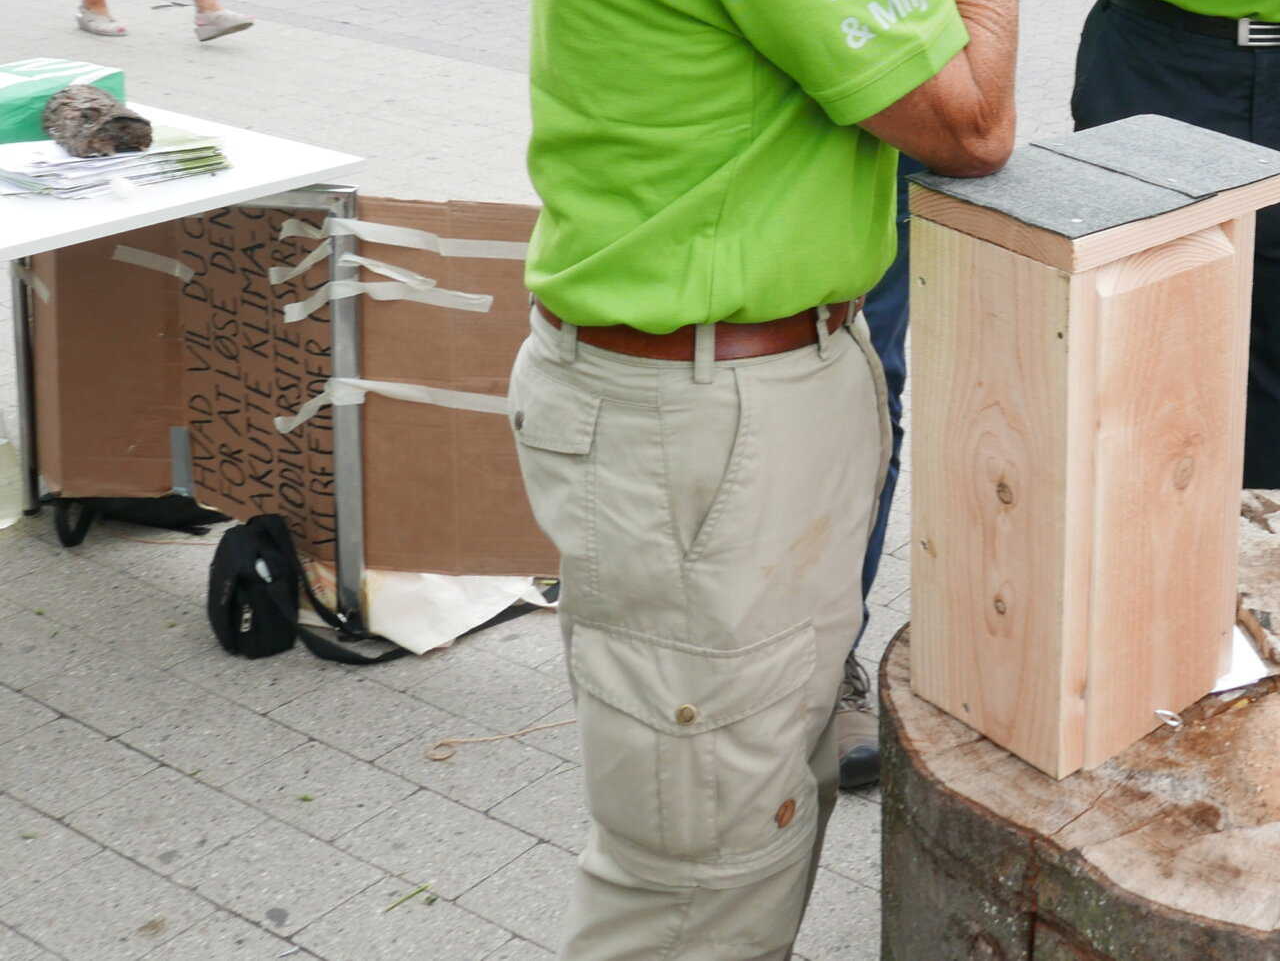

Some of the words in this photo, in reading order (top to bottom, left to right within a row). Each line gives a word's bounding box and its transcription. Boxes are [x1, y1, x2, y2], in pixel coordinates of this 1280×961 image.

[840, 17, 875, 49] &
[182, 249, 208, 302] DU
[240, 230, 269, 359] KLIMA-
[185, 321, 211, 372] VIL
[211, 289, 241, 381] LØSE
[215, 384, 241, 436] AT
[188, 394, 217, 492] HVAD
[219, 443, 246, 505] FOR
[244, 373, 275, 514] AKUTTE
